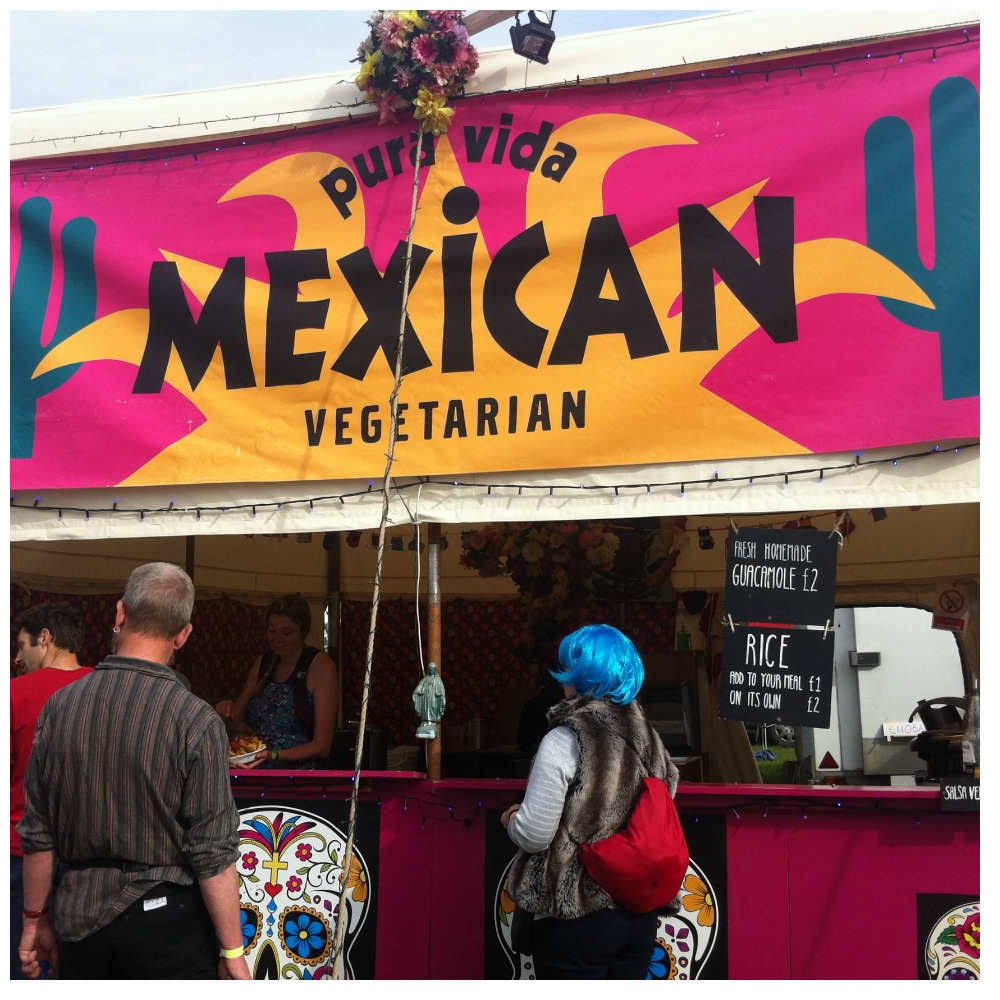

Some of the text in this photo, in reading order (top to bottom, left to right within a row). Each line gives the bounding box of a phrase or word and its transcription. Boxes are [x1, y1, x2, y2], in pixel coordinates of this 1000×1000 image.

[318, 112, 578, 221] pura vida
[303, 389, 587, 447] VEGETARIAN
[734, 540, 813, 563] FRESH HOMEMADE
[732, 563, 819, 592] GUACAMOLE £2
[745, 633, 791, 669] RICE
[729, 670, 821, 693] ADD TO YOUR MEAL £1
[729, 689, 820, 714] ON ITS OWN £2
[943, 784, 981, 801] SALSA VE
